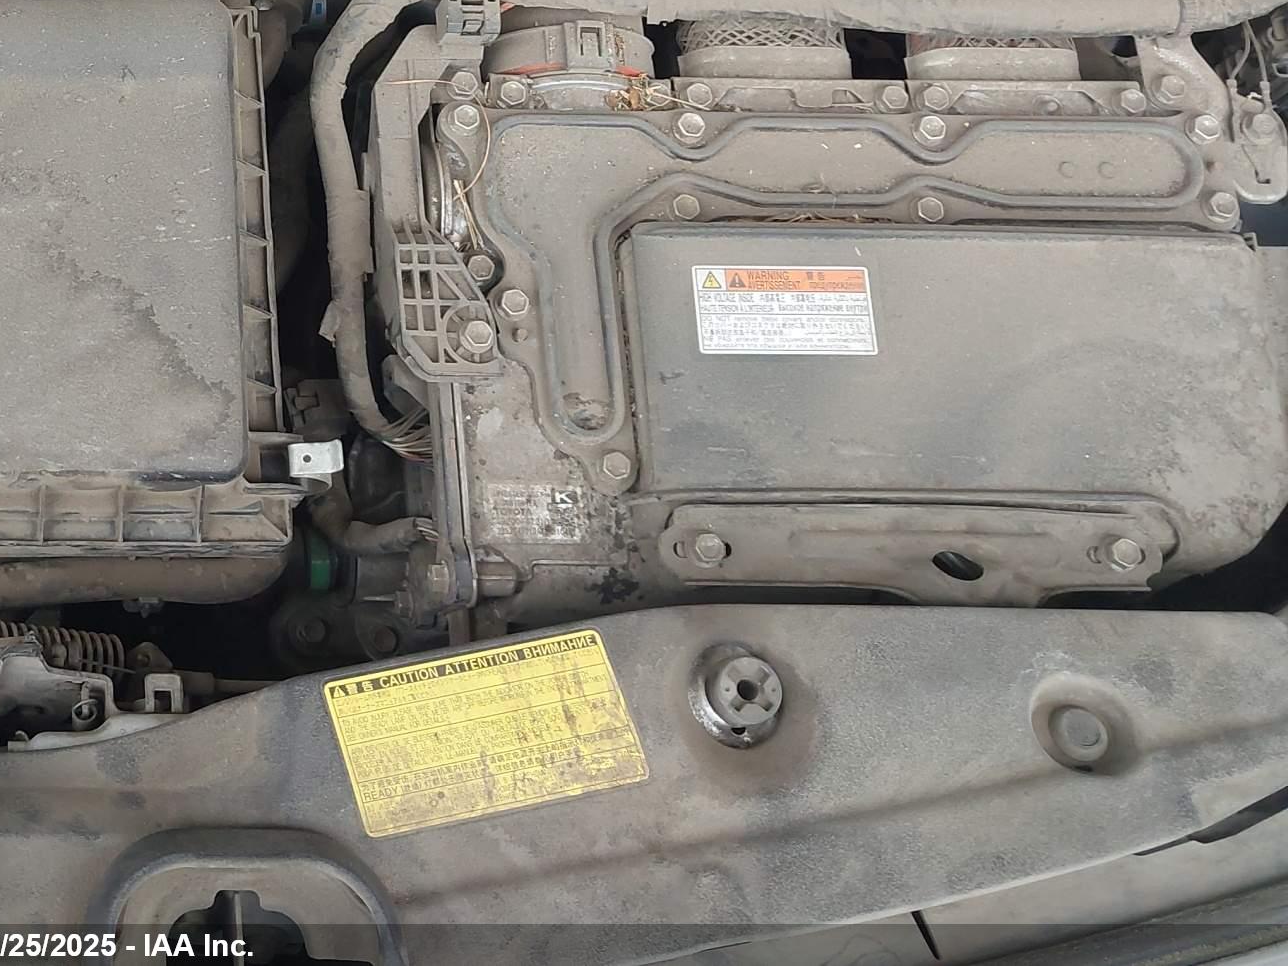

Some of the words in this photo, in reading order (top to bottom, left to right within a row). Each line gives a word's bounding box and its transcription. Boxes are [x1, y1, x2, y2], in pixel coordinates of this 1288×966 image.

[747, 271, 789, 280] WARNING
[378, 666, 438, 688] CAUTION
[443, 650, 519, 675] ATTENTION
[522, 634, 595, 659] ВНИМАНИЕ
